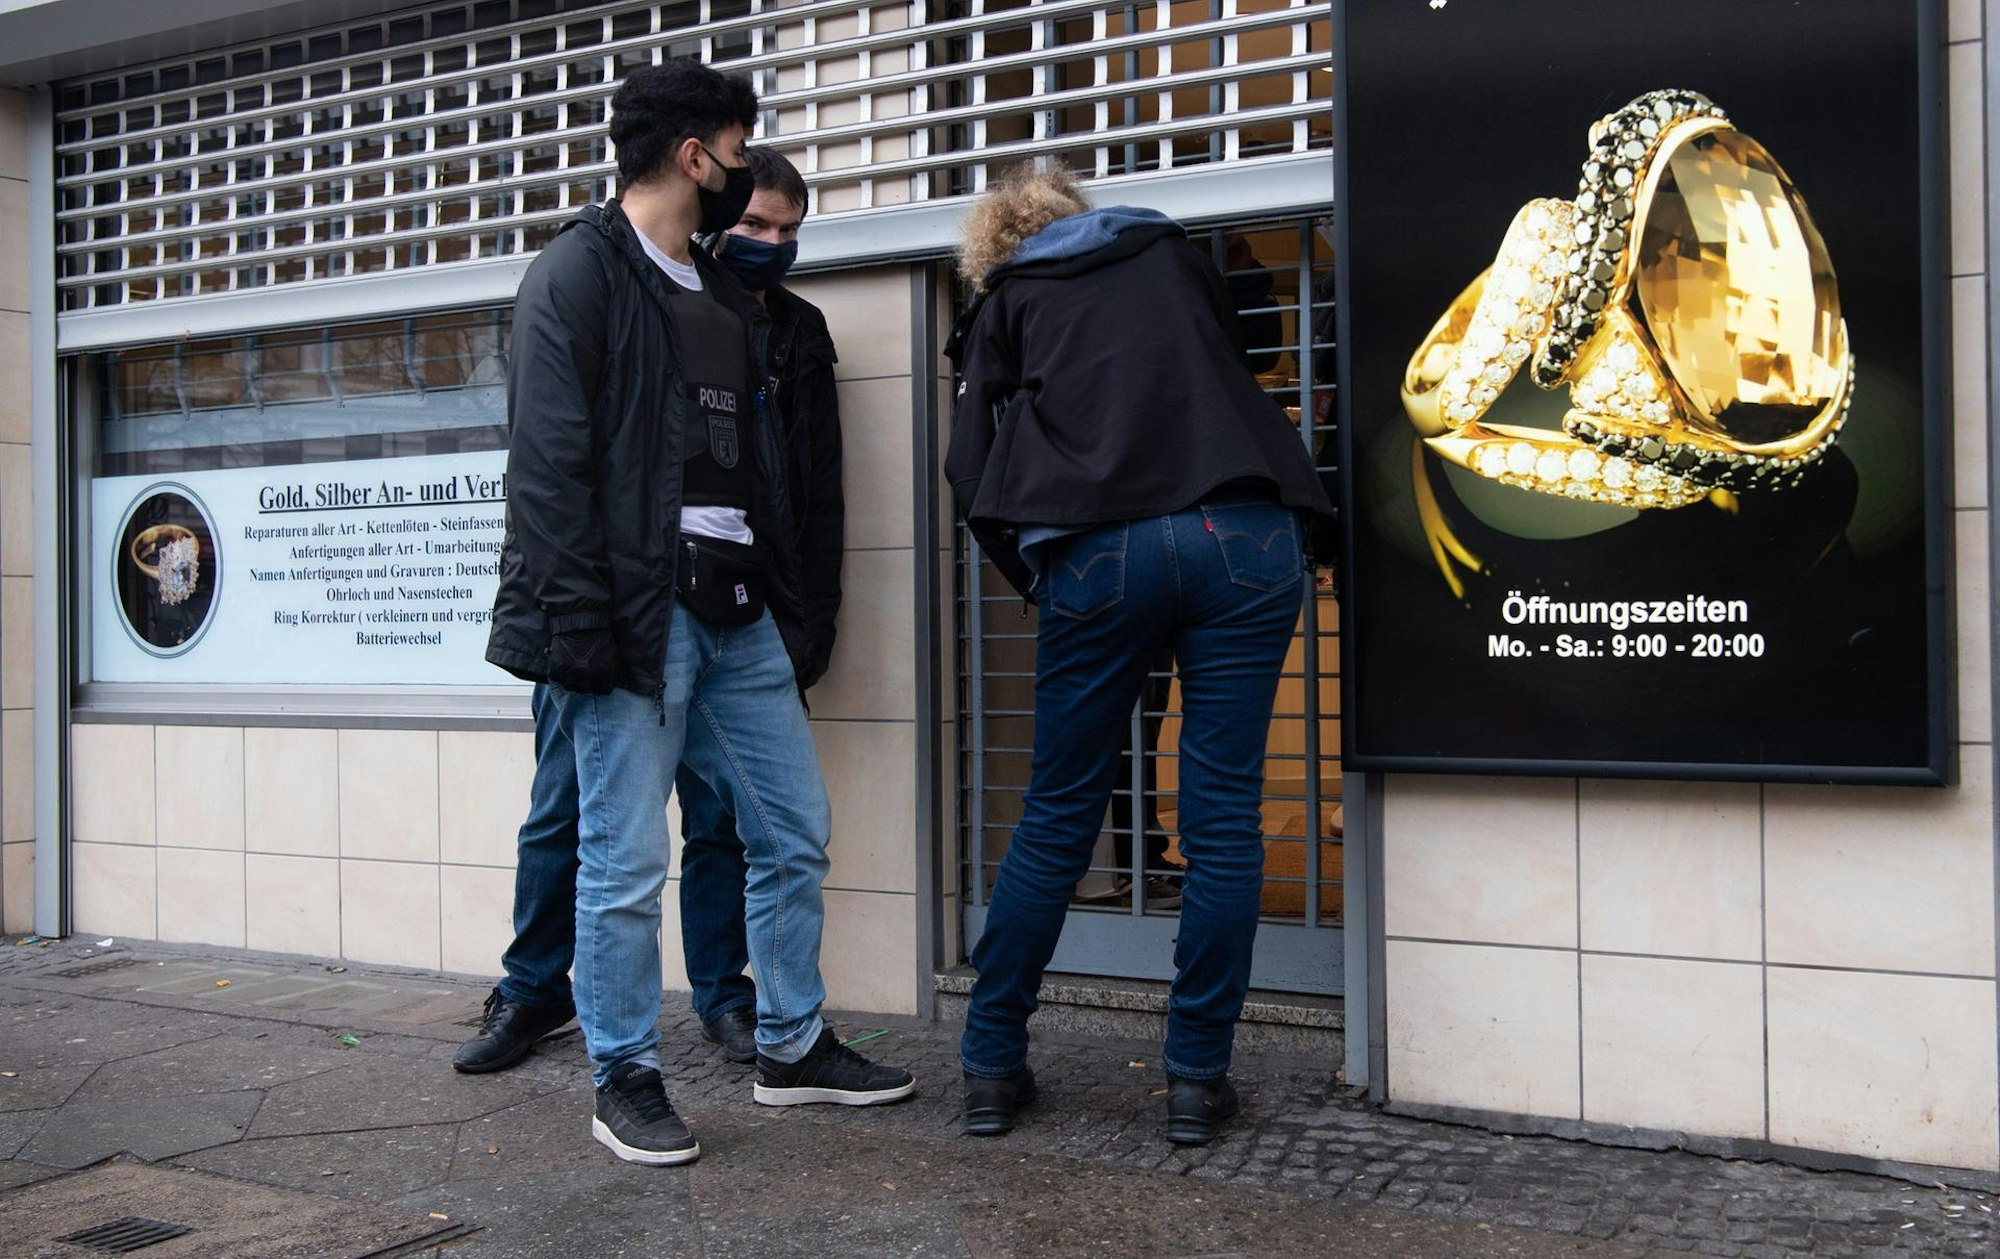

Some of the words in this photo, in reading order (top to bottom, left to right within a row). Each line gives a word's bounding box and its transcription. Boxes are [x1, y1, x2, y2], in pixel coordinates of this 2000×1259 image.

[259, 485, 309, 509] Gold,
[315, 482, 372, 507] Silber
[376, 480, 413, 503] An-
[420, 476, 458, 501] und
[244, 526, 309, 542] Reparaturen
[311, 522, 335, 536] aller
[337, 523, 356, 536] Art
[367, 519, 430, 535] Kettenlöten
[440, 516, 504, 531] Steinfassen
[290, 545, 365, 560] Anfertigungen
[368, 542, 393, 556] aller
[395, 542, 414, 556] Art
[250, 569, 285, 581] Namen
[287, 566, 363, 582] Anfertigungen
[367, 565, 387, 579] und
[390, 564, 444, 578] Gravuren
[326, 588, 370, 601] Ohrloch
[373, 587, 394, 600] und
[398, 586, 473, 600] Nasenstechen
[274, 611, 298, 627] Ring
[301, 610, 356, 624] Korrektur
[366, 609, 428, 623] verkleinern
[432, 609, 453, 622] und
[1502, 590, 1748, 630] Öffnungszeiten
[356, 631, 442, 645] Batteriewechsel
[1488, 634, 1532, 657] Mo.
[1556, 634, 1603, 657] Sa.:
[1611, 634, 1667, 657] 9:00
[1691, 633, 1765, 657] 20:00
